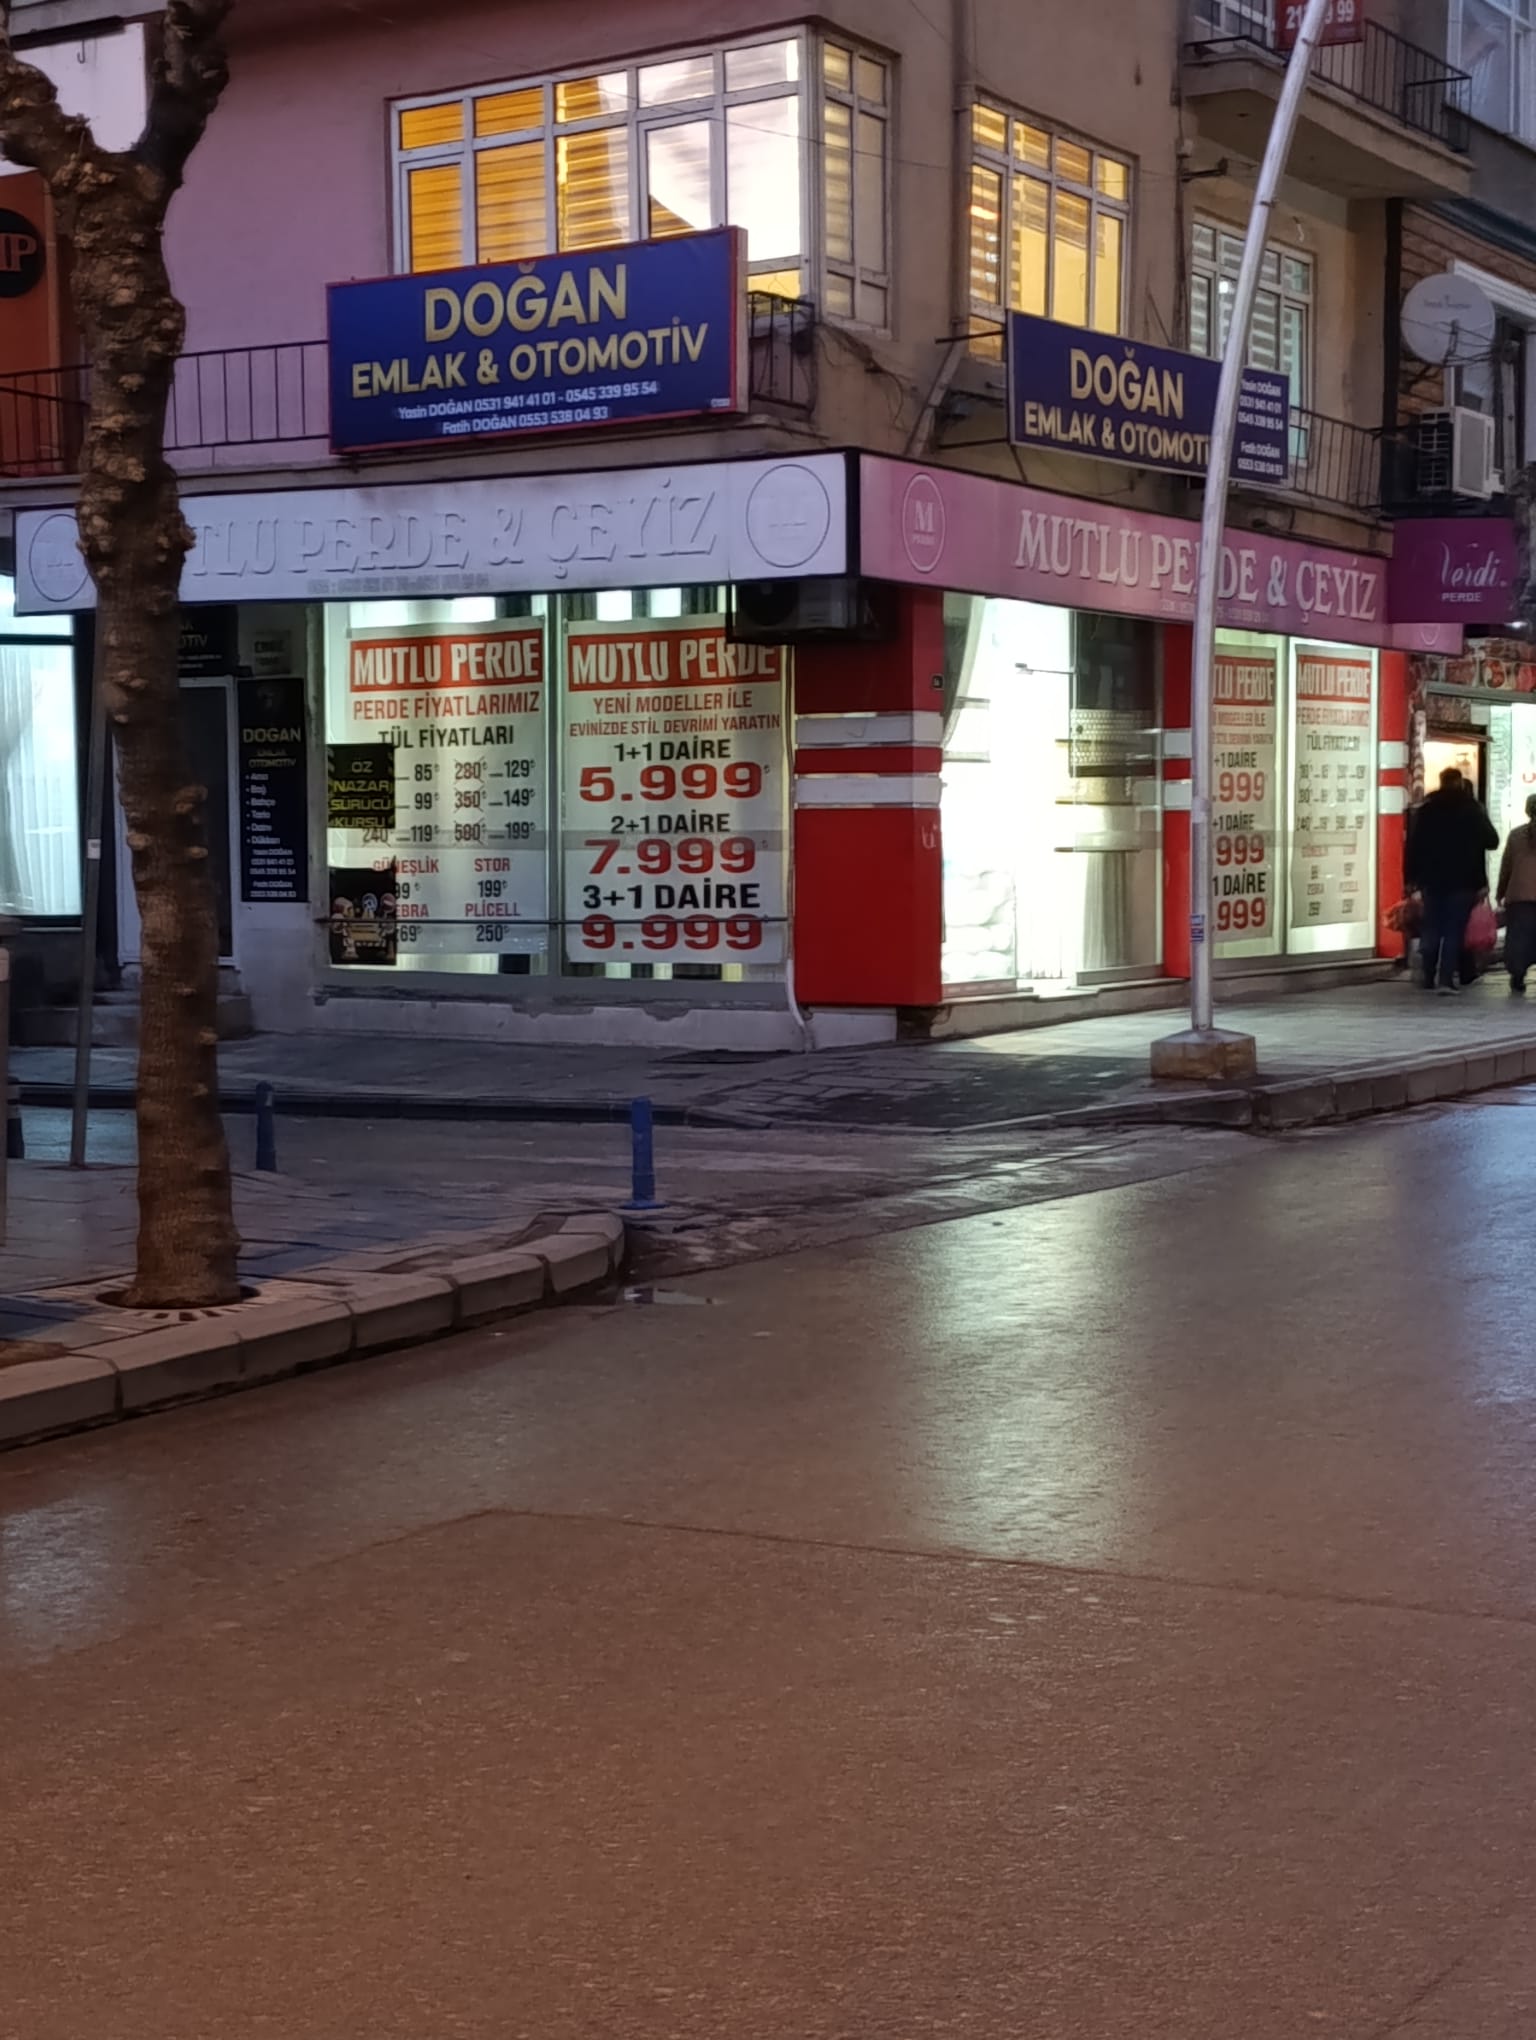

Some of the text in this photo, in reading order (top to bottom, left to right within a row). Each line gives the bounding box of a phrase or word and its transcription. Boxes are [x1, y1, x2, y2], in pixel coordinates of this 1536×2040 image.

[424, 261, 627, 343] DOĞAN
[352, 317, 709, 398] EMLAK & OTOMOTİV
[1070, 346, 1184, 420] DOĞAN
[475, 398, 501, 413] 0531
[504, 396, 524, 410] 941
[527, 394, 541, 407] 41
[543, 392, 556, 405] 01
[566, 388, 597, 402] 0545
[1024, 401, 1210, 467] EMLAK & OTOMOTİ
[290, 512, 470, 574] PERDE
[545, 478, 718, 579] ÇEYİZ
[914, 500, 935, 533] M
[1015, 509, 1377, 623] MUTLU PEDE & ÇEYİZ
[354, 638, 539, 686] MUTLU PERDE
[572, 637, 776, 685] MUTLU PERDE
[354, 691, 540, 720] PERDE FİYATLARIMIZ
[593, 687, 753, 714] YENİ MODELLER İLE
[378, 723, 514, 749] TÜL FİYATLARI
[570, 713, 780, 737] EVİNİZDE STİL DEVRİMİ YARATIN
[614, 735, 731, 762] 1+1 DAİRE
[611, 809, 730, 834] 2+1 DAİRE
[474, 858, 511, 872] STOR
[583, 877, 760, 909] 3+1 DAİRE
[1223, 869, 1266, 896] DAİRE
[465, 901, 521, 917] PLİCELL
